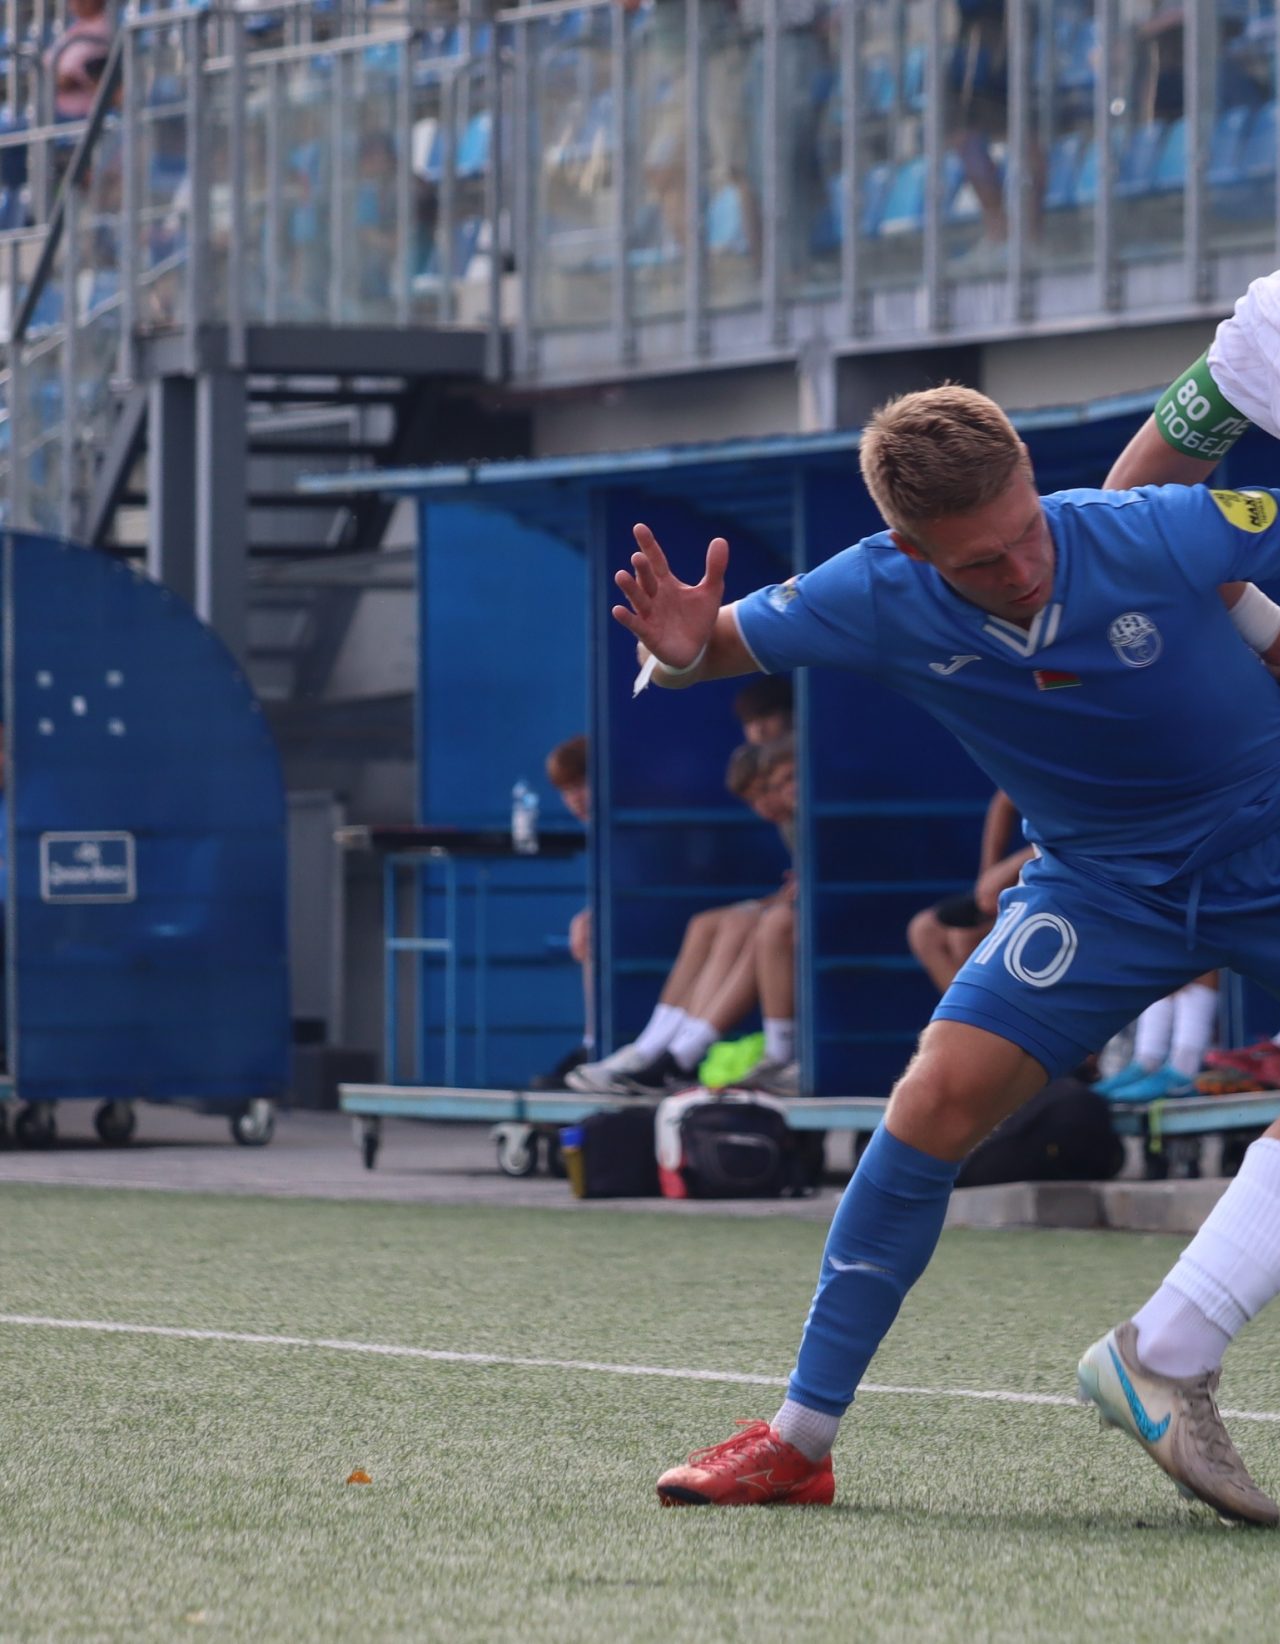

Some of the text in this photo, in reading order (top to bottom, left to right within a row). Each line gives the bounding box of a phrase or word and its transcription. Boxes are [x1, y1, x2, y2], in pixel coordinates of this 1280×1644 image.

[1160, 400, 1234, 457] ПОБЕД
[1177, 378, 1250, 436] 80 ЛЕ
[974, 901, 1078, 988] 10
